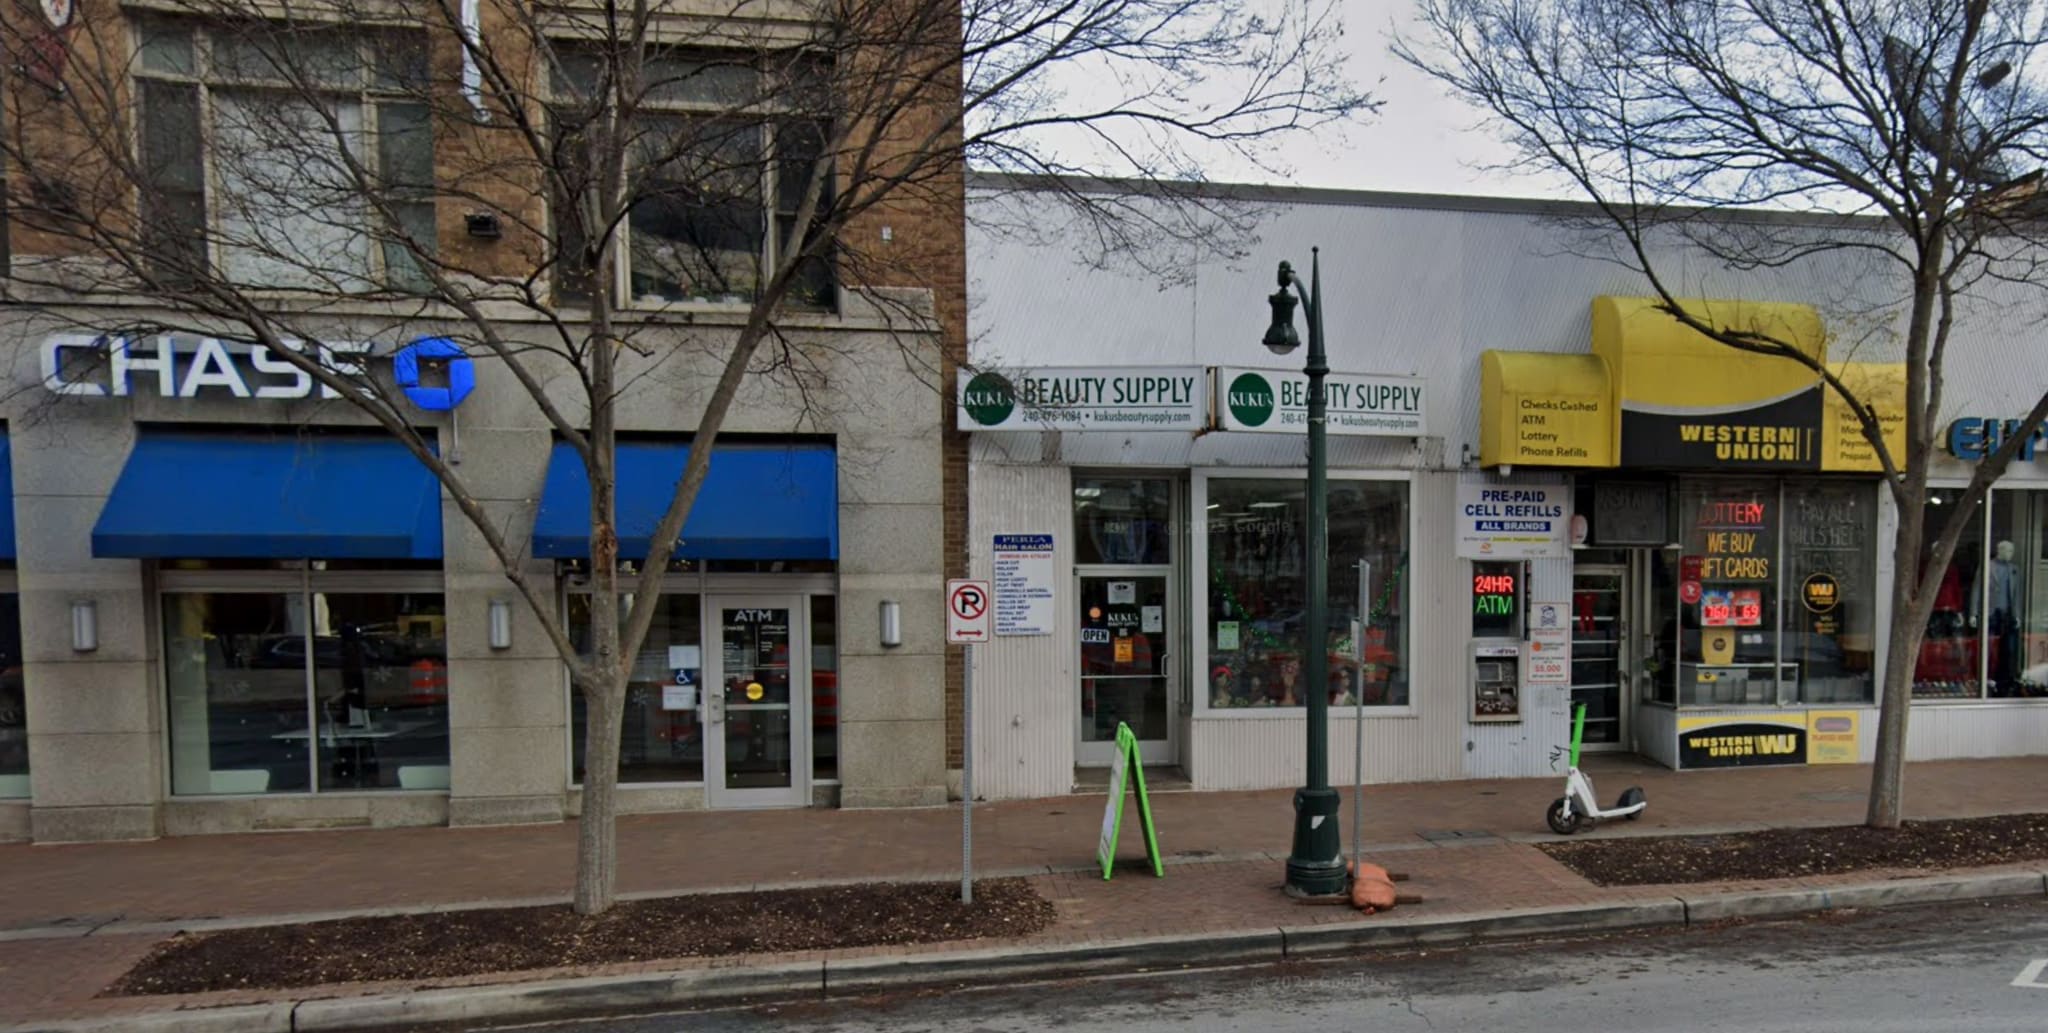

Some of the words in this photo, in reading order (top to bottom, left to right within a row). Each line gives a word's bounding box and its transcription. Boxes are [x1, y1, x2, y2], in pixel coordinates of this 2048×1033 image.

[40, 333, 379, 399] CHASE
[1025, 377, 1107, 404] BEAUTY
[1113, 377, 1194, 404] SUPPLY
[1356, 384, 1422, 412] SUPPLY
[1521, 400, 1558, 410] Checks
[1560, 401, 1599, 412] Cashed
[1094, 410, 1192, 424] kukusbeautysupply.com
[1341, 414, 1420, 430] kukusbeautysupply.com
[1521, 415, 1546, 425] ATM
[1521, 430, 1559, 442] Lottery
[1680, 425, 1795, 442] WESTERN
[1521, 446, 1554, 457] Phone
[1556, 447, 1588, 458] Refills
[1716, 443, 1794, 460] UNION
[1482, 490, 1546, 503] PRE-PAID
[1465, 504, 1500, 516] CELL
[1505, 505, 1562, 517] REFILLS
[1481, 521, 1501, 530] ALL
[1503, 522, 1546, 531] BRANDS
[1707, 532, 1727, 553] WE
[1730, 532, 1756, 553] BUY
[1725, 557, 1769, 578] CARDS
[1475, 576, 1514, 593] 24HR
[1476, 595, 1513, 615] ATM
[734, 610, 772, 622] ATM
[1083, 629, 1108, 640] OPEN
[1689, 736, 1753, 748] WESTERN
[1709, 746, 1753, 757] UNION
